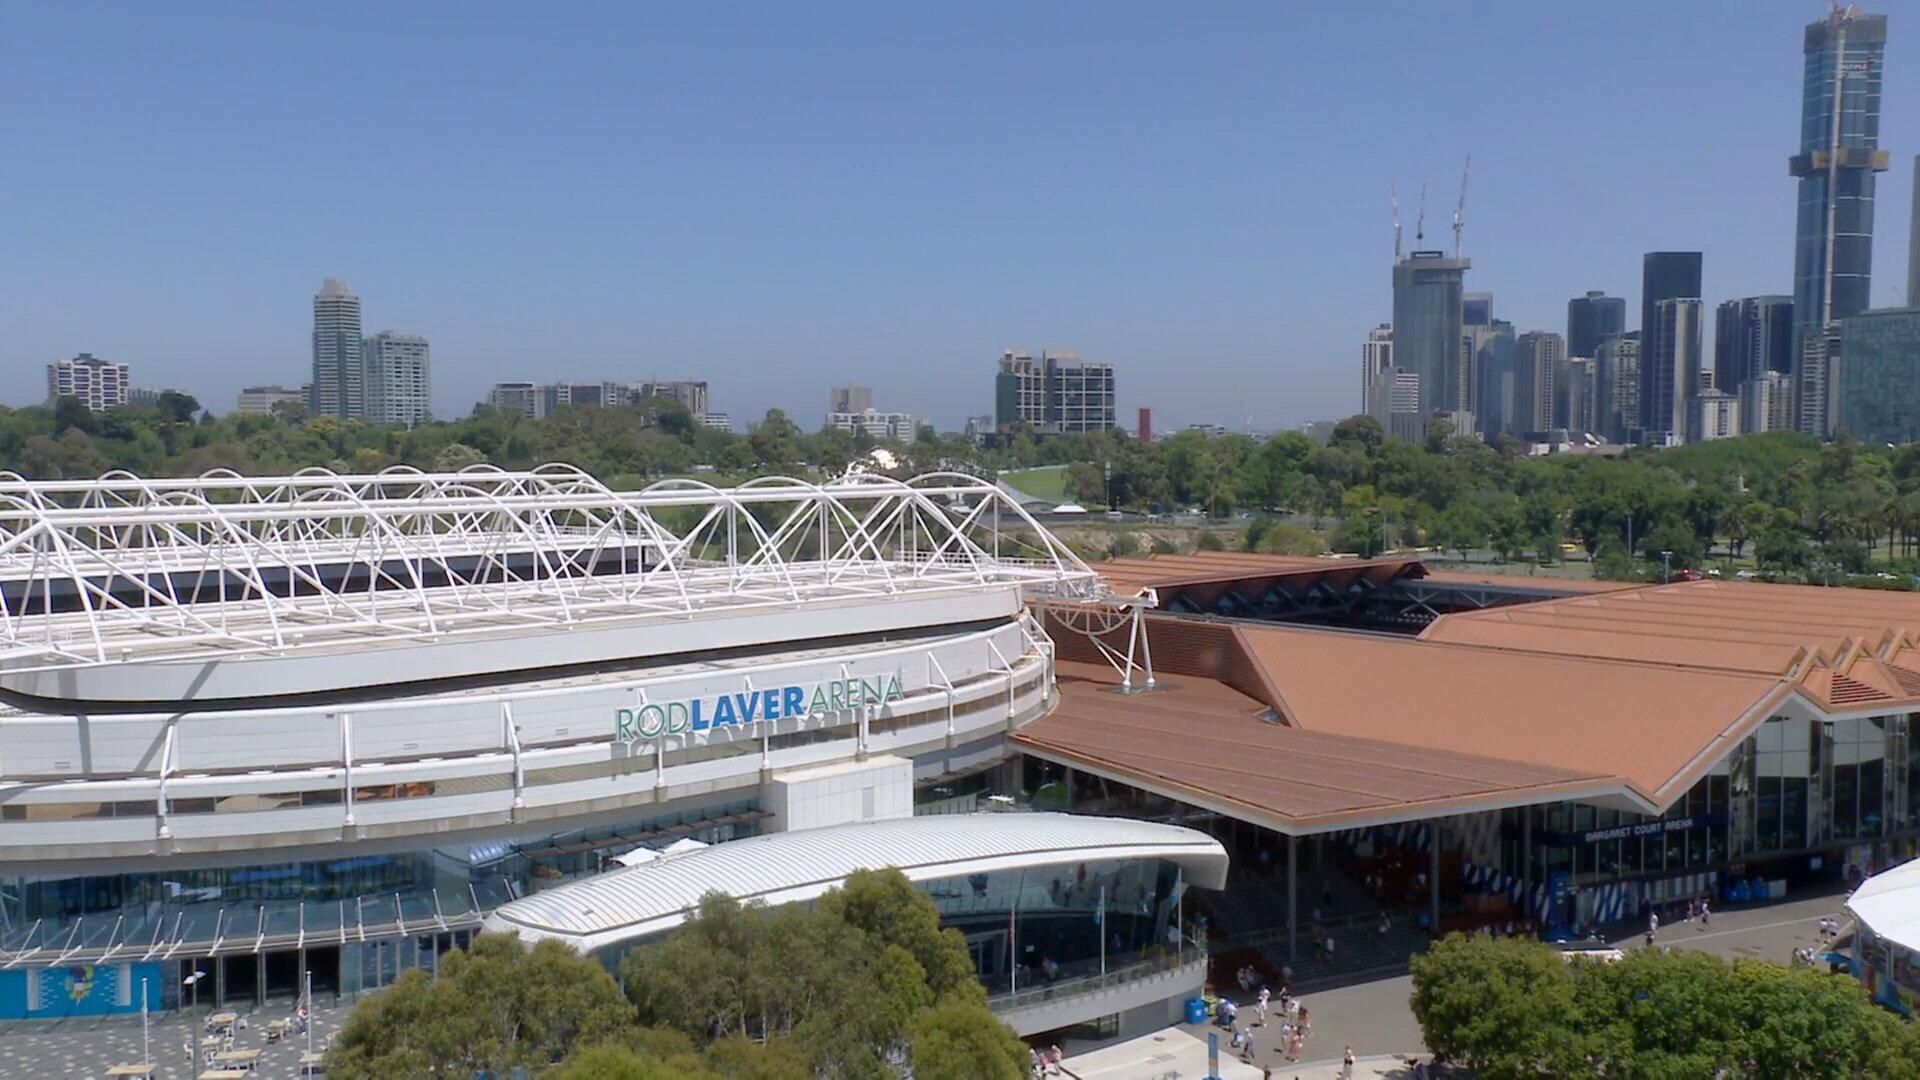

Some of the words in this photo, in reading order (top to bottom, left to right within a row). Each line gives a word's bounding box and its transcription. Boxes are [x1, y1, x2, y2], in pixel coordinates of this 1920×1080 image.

[616, 702, 688, 742] ROD
[692, 686, 807, 731] LAVER
[809, 674, 904, 711] ARENA
[1585, 827, 1631, 842] MARGARET
[1634, 823, 1661, 835] COURT
[1665, 818, 1693, 831] ARENA
